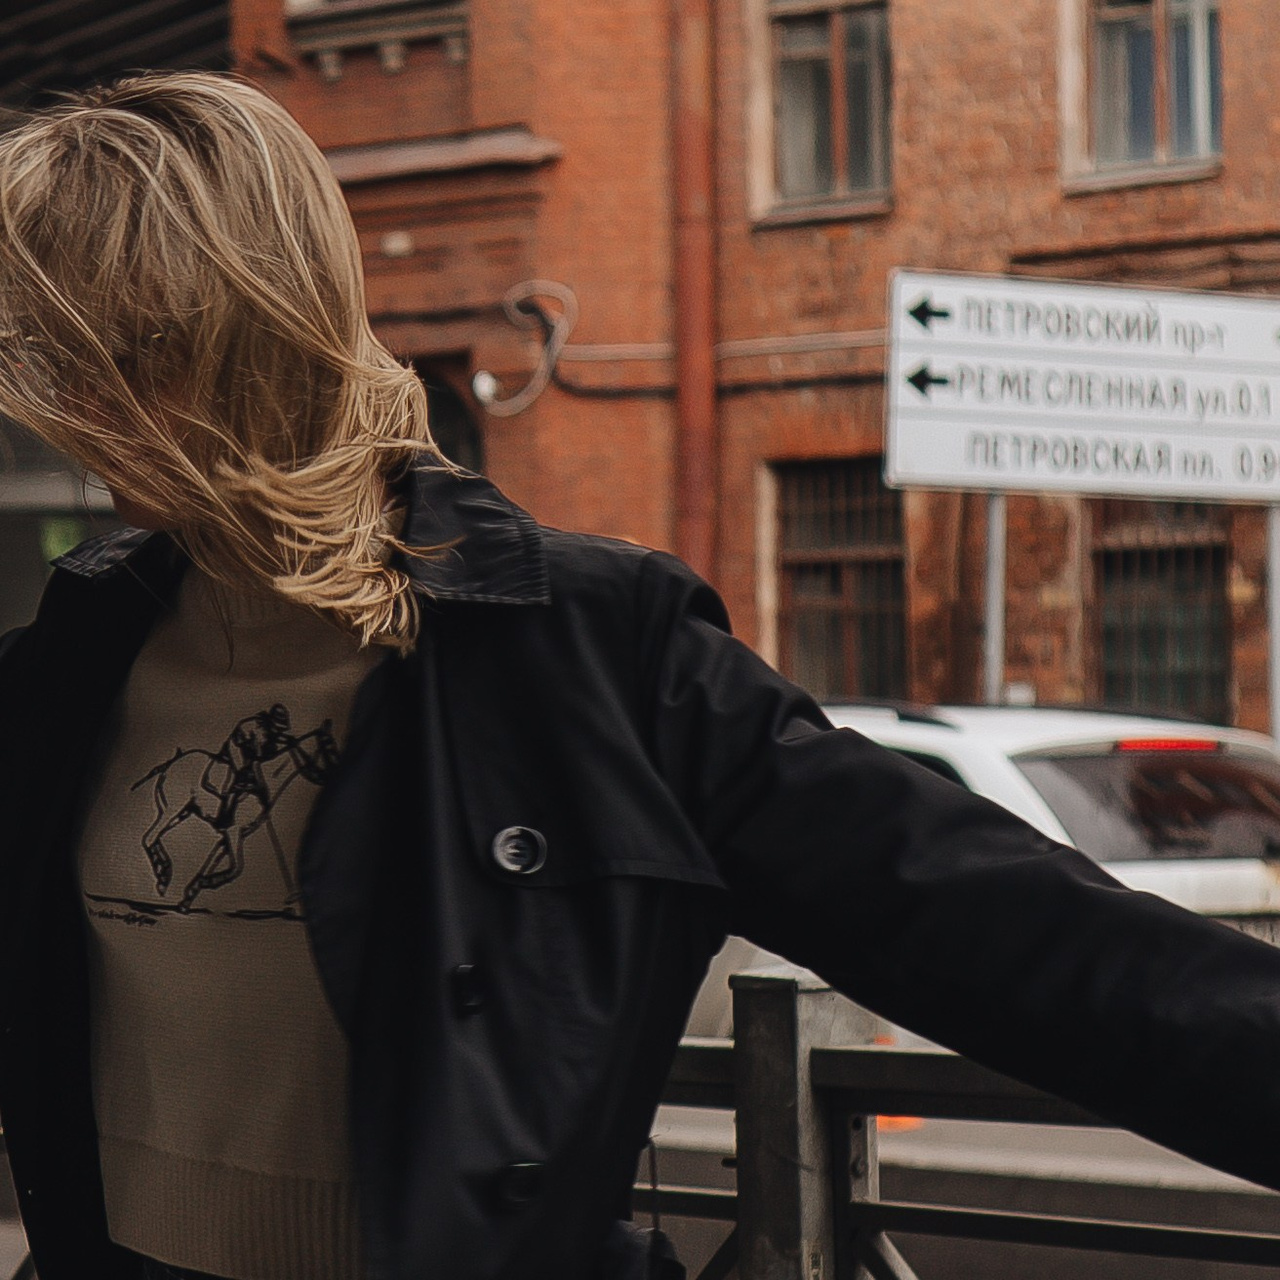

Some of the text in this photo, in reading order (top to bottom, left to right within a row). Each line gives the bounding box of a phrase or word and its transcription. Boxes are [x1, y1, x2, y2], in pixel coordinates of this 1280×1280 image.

[962, 296, 1226, 355] ПЕТРОВСКИЙ пр-т
[957, 363, 1188, 411] РЕМЕСЛЕННАЯ
[968, 430, 1172, 477] ПЕТРОВСКАЯ
